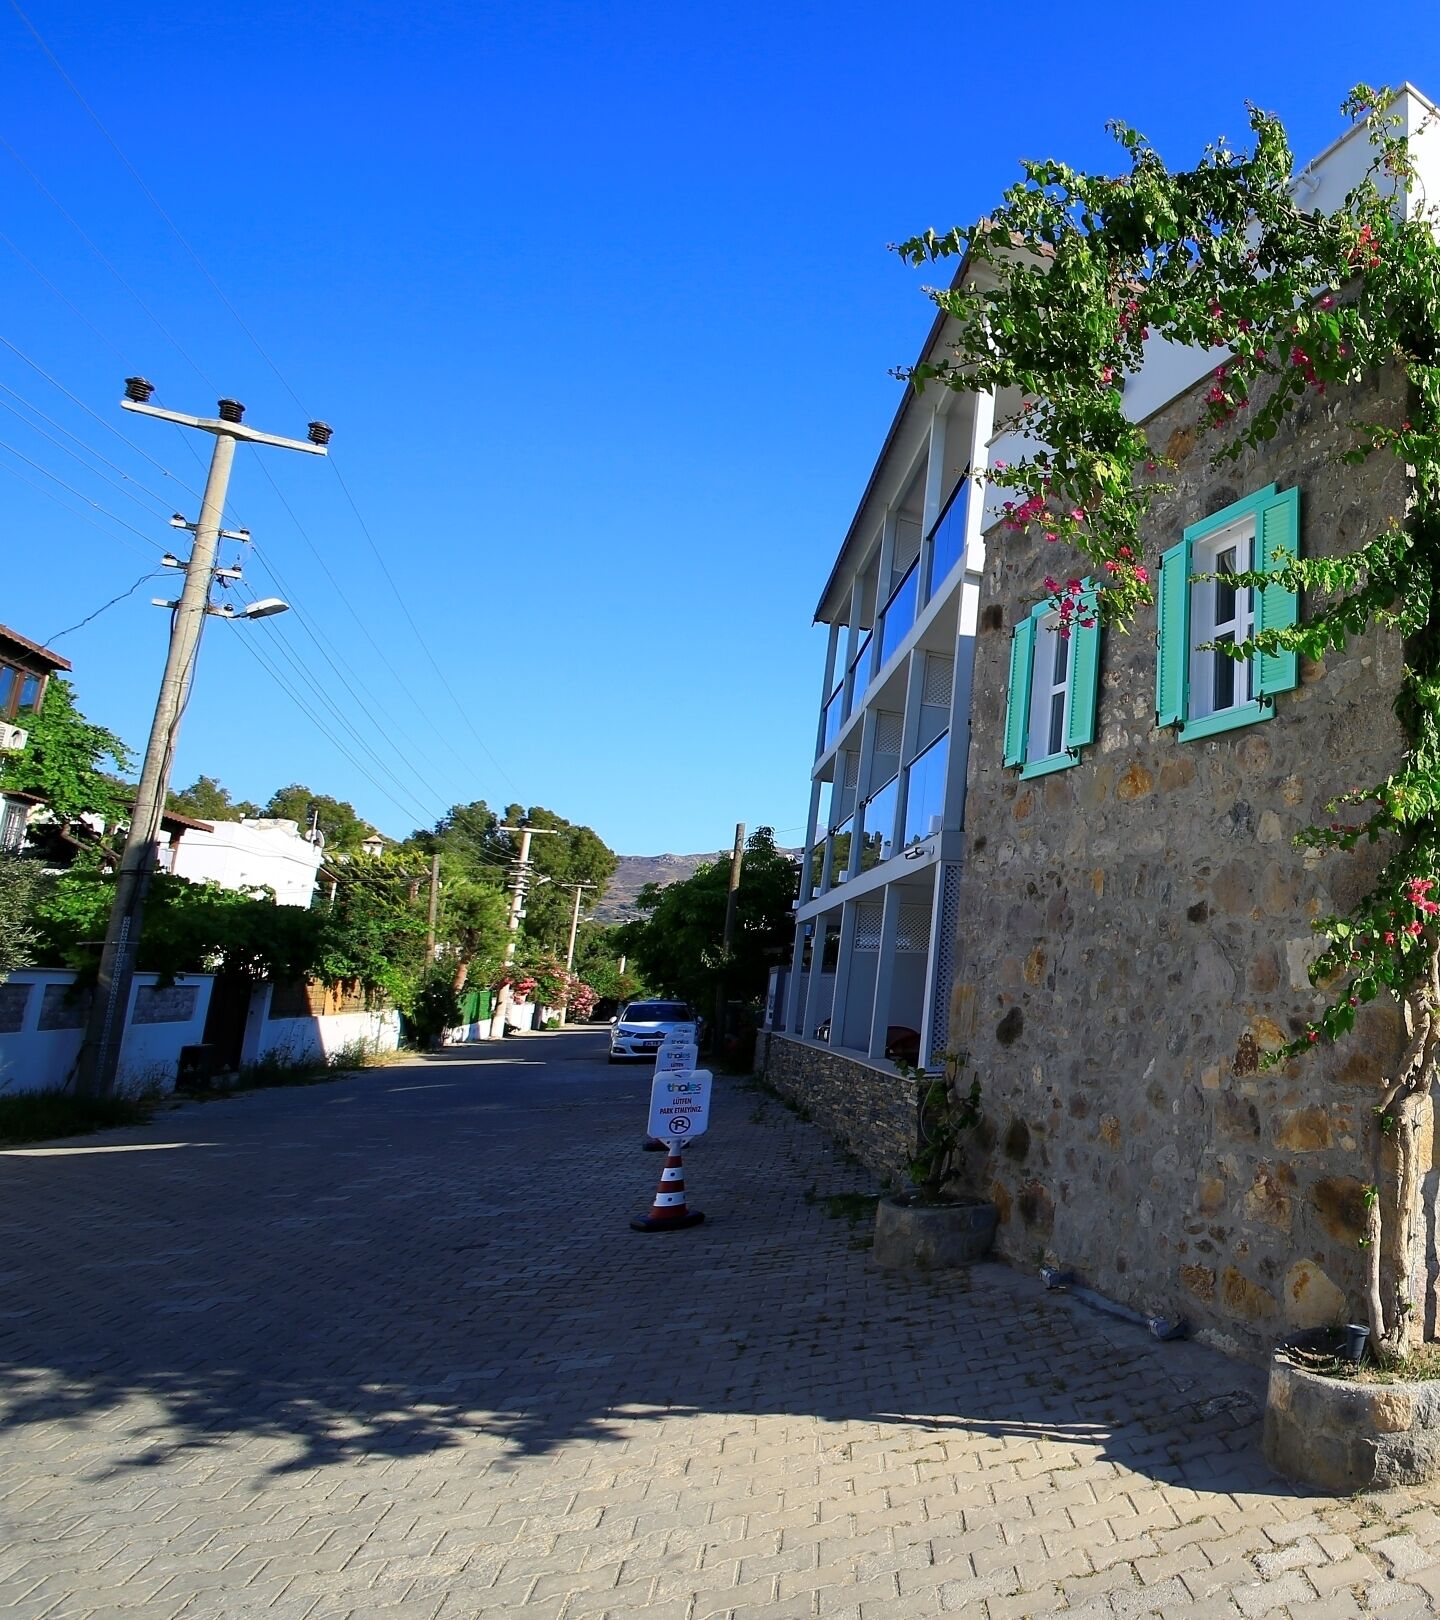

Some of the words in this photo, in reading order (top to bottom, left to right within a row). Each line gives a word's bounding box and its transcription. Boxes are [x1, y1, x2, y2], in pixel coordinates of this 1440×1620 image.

[667, 1081, 702, 1093] thales
[673, 1096, 692, 1105] LÜTFEN
[659, 1107, 674, 1115] PARK
